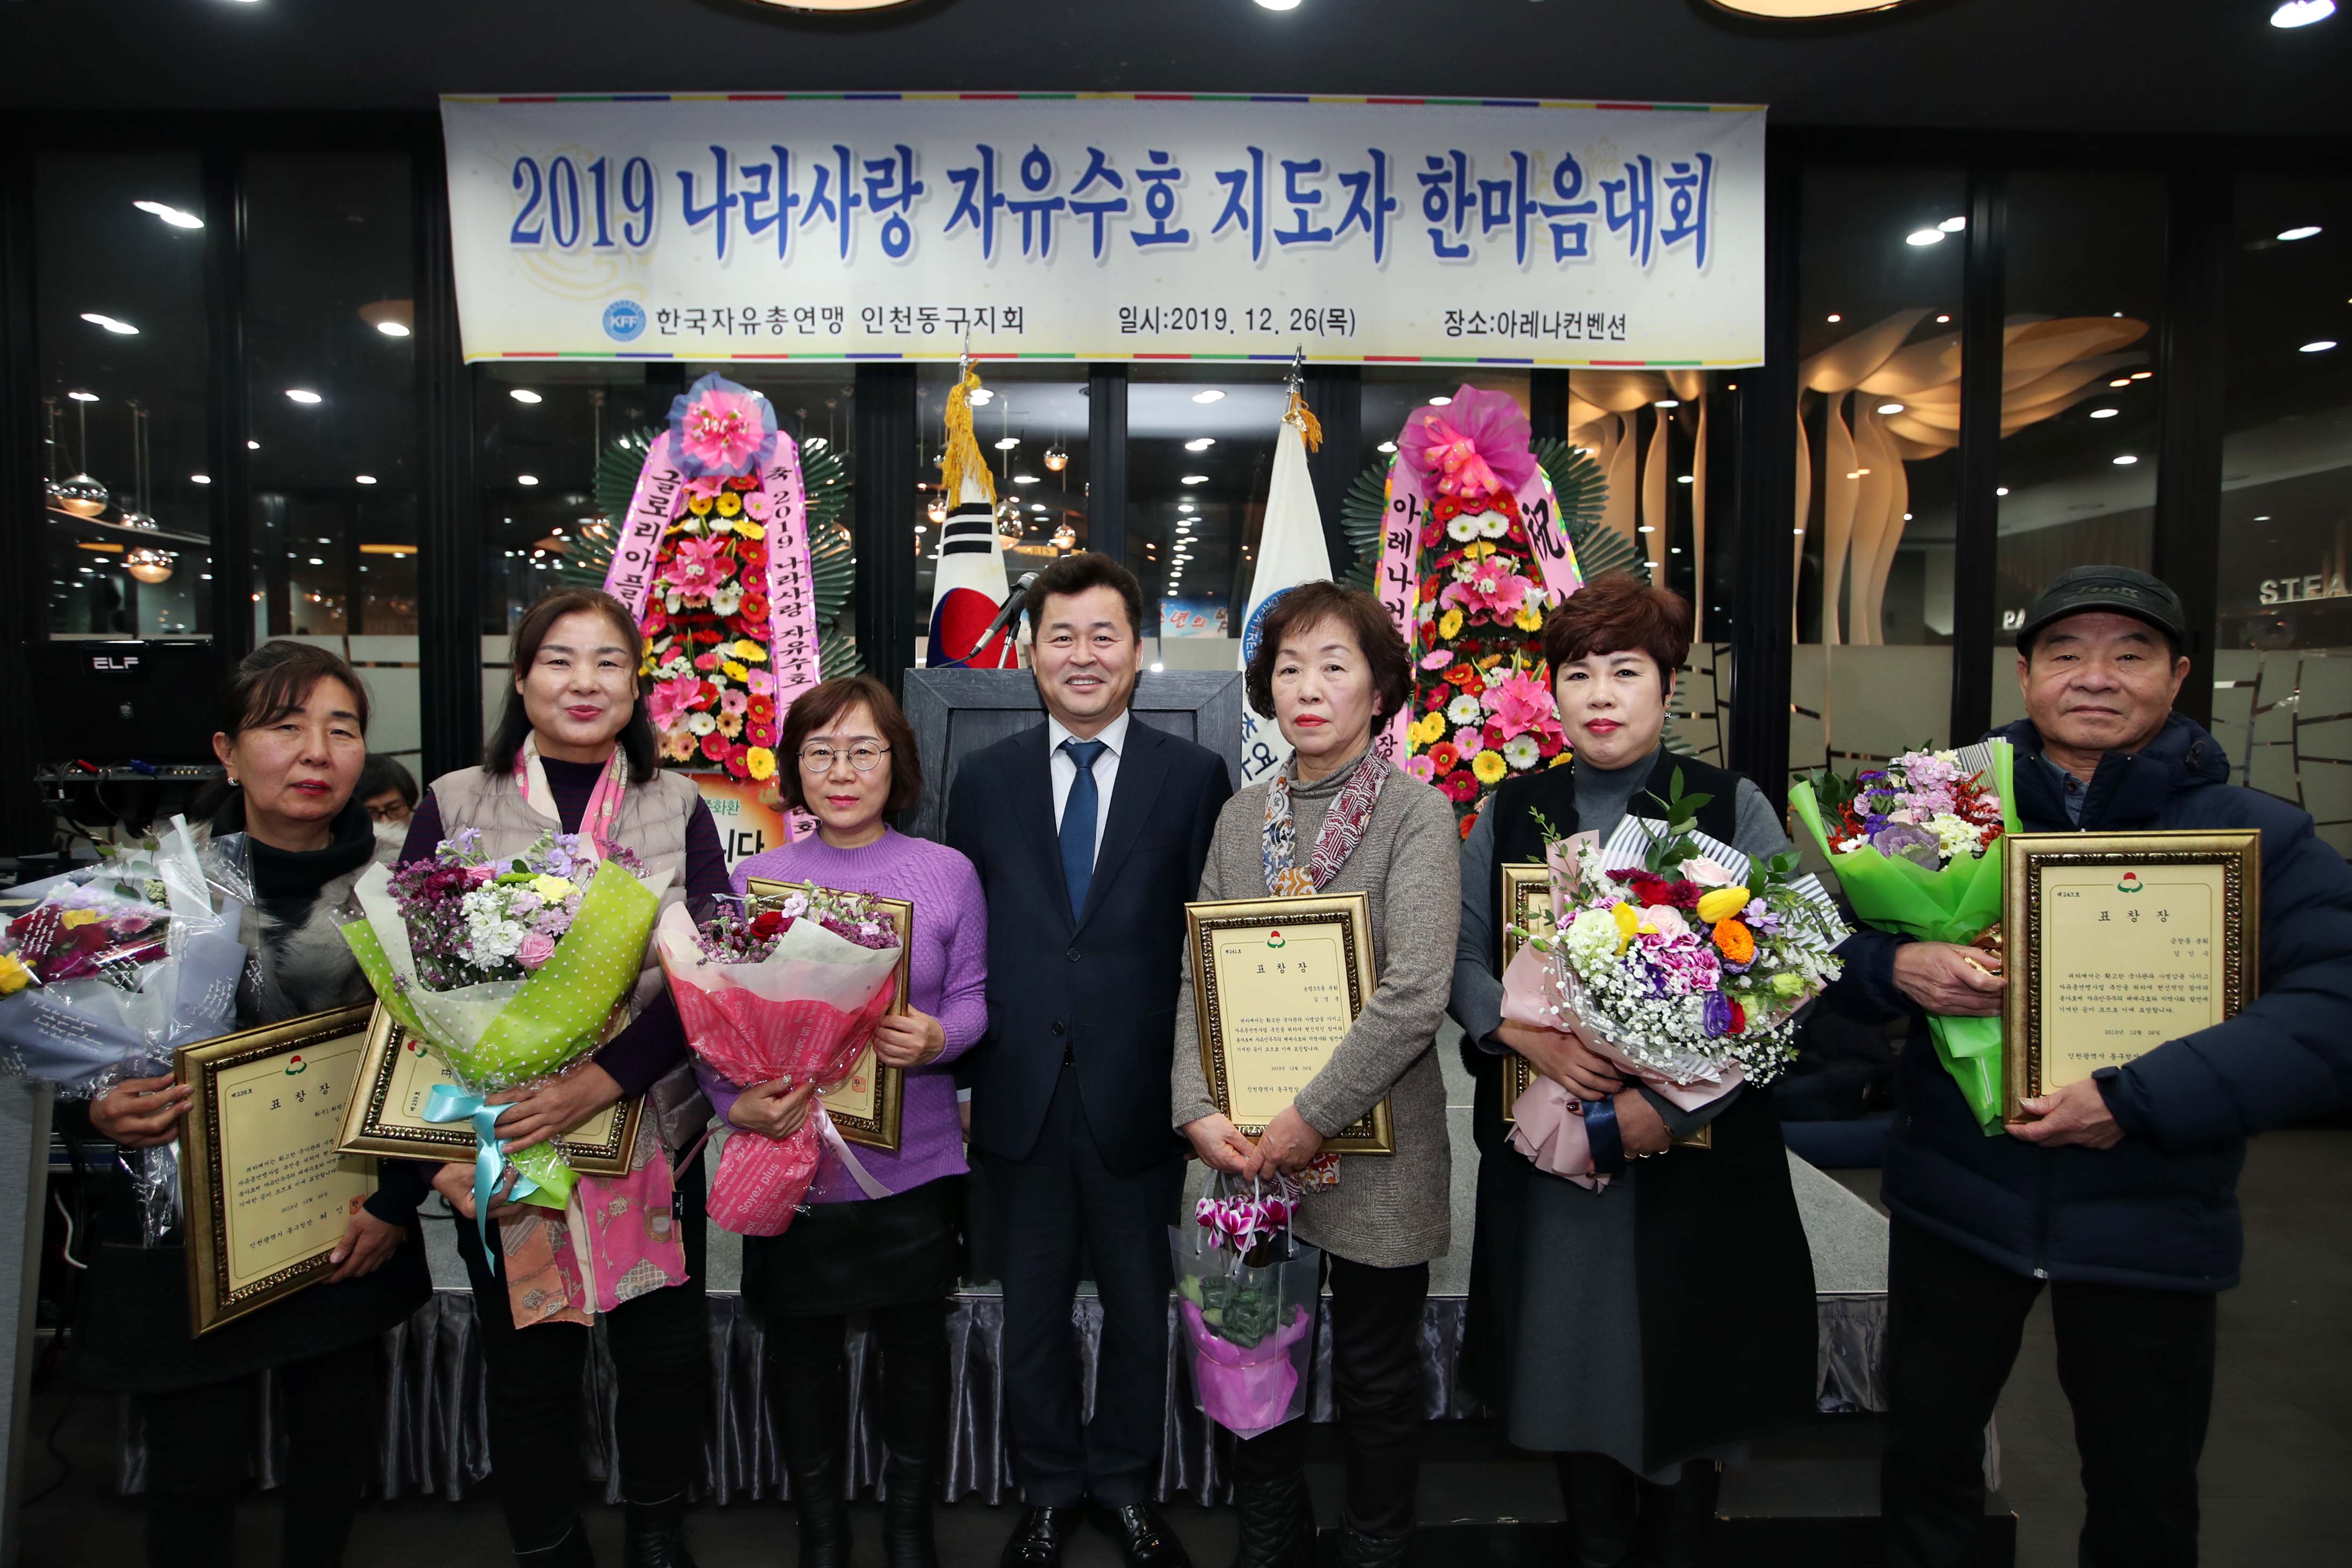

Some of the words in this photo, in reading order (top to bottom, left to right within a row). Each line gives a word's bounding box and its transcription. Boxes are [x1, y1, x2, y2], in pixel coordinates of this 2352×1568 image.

[512, 157, 653, 247] 2019
[677, 144, 923, 260] 나라사랑
[943, 144, 1189, 260] 자유수호
[1212, 146, 1396, 263] 지도자
[1418, 150, 1712, 268] 한마음대회
[611, 315, 639, 327] KFF
[657, 306, 844, 335] 한국자유총연맹
[862, 306, 1024, 335] 인천동구지회
[1118, 306, 1234, 335] 일시:2019.
[1245, 309, 1279, 335] 12.
[1290, 307, 1356, 337] 26(목)
[1444, 310, 1626, 340] 장소:아레나컨벤션
[765, 466, 793, 481] 축
[773, 491, 793, 549] 2019
[1522, 498, 1566, 562] 祝
[774, 557, 808, 618] 나라사랑
[93, 656, 139, 669] ELF
[778, 625, 812, 688] 자유수호
[737, 1186, 765, 1214] Soyez
[761, 1163, 780, 1185] plus
